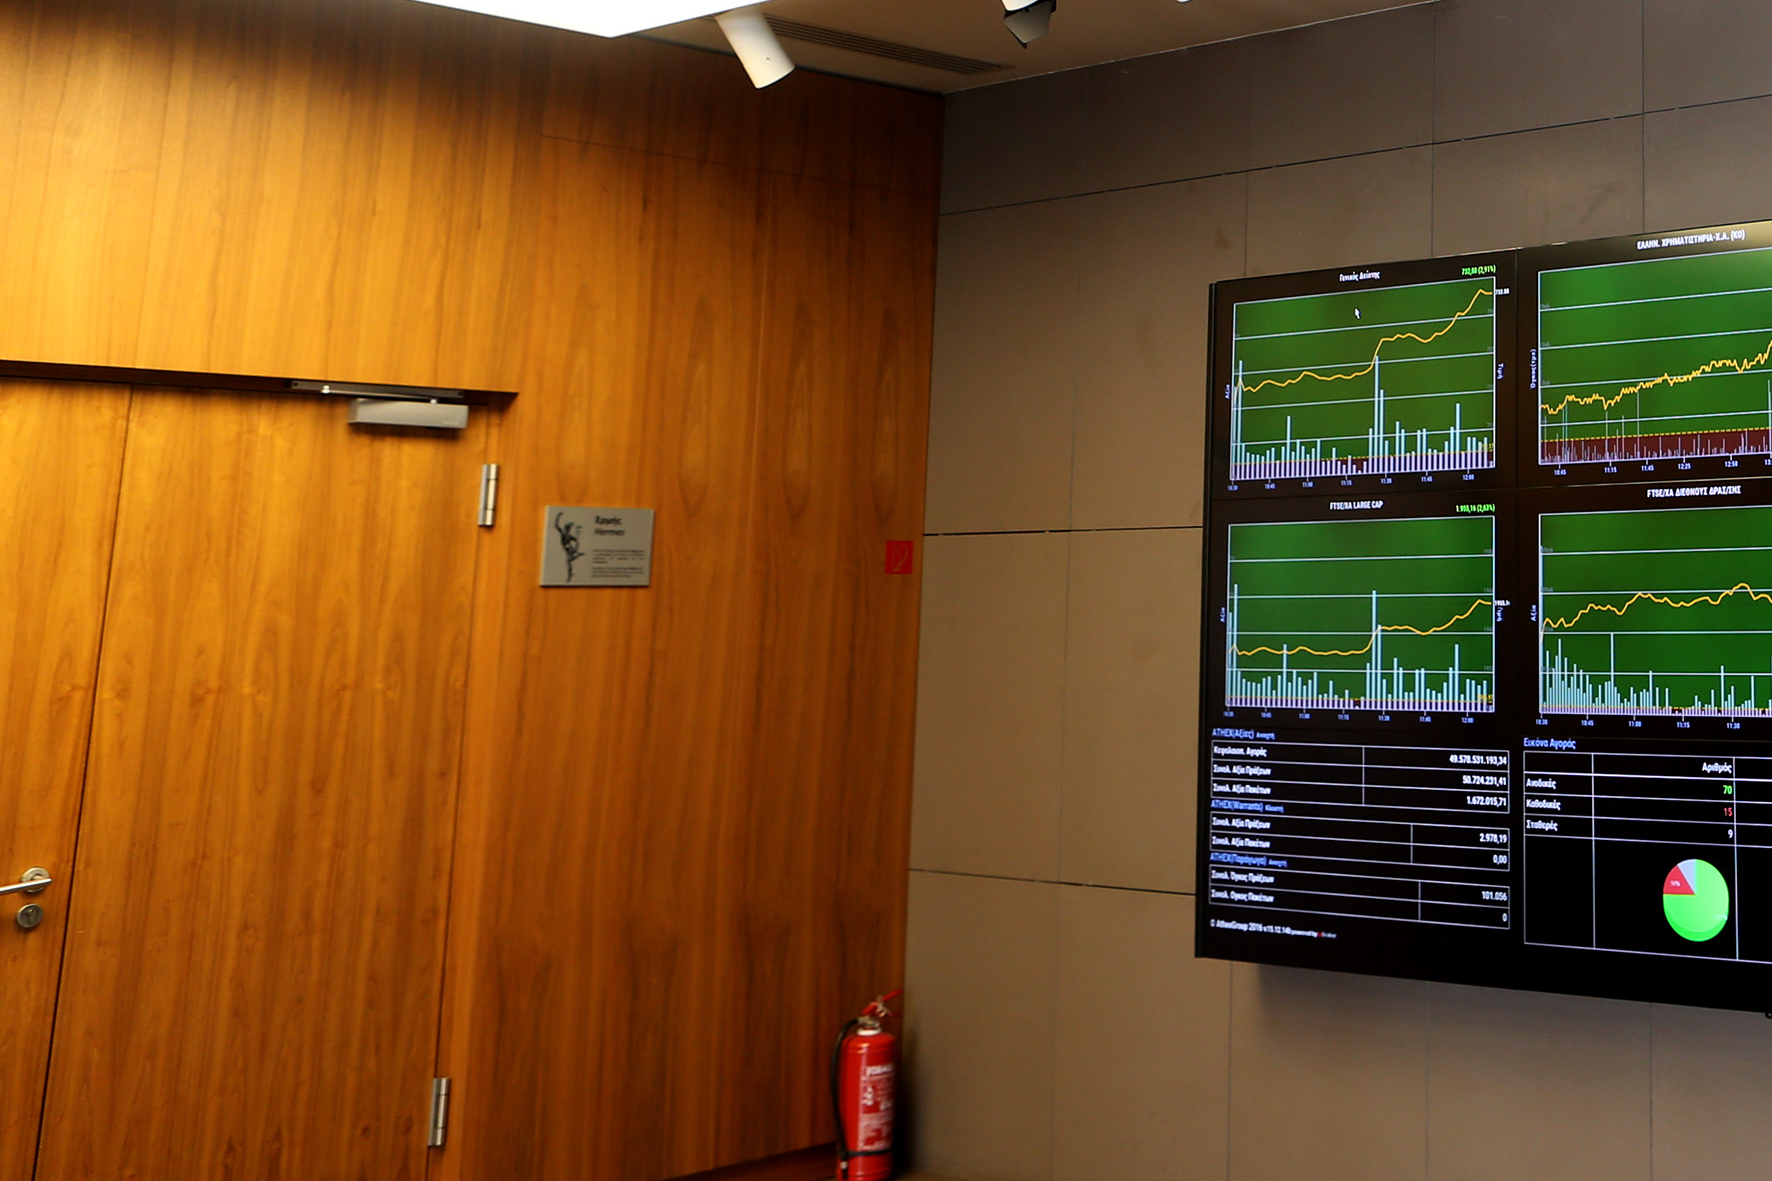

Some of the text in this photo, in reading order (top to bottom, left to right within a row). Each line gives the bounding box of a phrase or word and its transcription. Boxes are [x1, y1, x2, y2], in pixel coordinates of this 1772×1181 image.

[1353, 501, 1371, 510] LARGE
[1371, 500, 1384, 509] CAP
[1523, 737, 1577, 750] Εικόνα Αγοράς
[1702, 762, 1733, 774] Αριθμός
[1526, 778, 1557, 789] Ανοδικές
[1723, 785, 1733, 795] 70
[1724, 807, 1733, 816] 15
[1526, 820, 1558, 831] Σταθερές
[1727, 829, 1734, 839] 9
[1479, 832, 1507, 845] 2.978,19
[1492, 854, 1508, 865] 0,00
